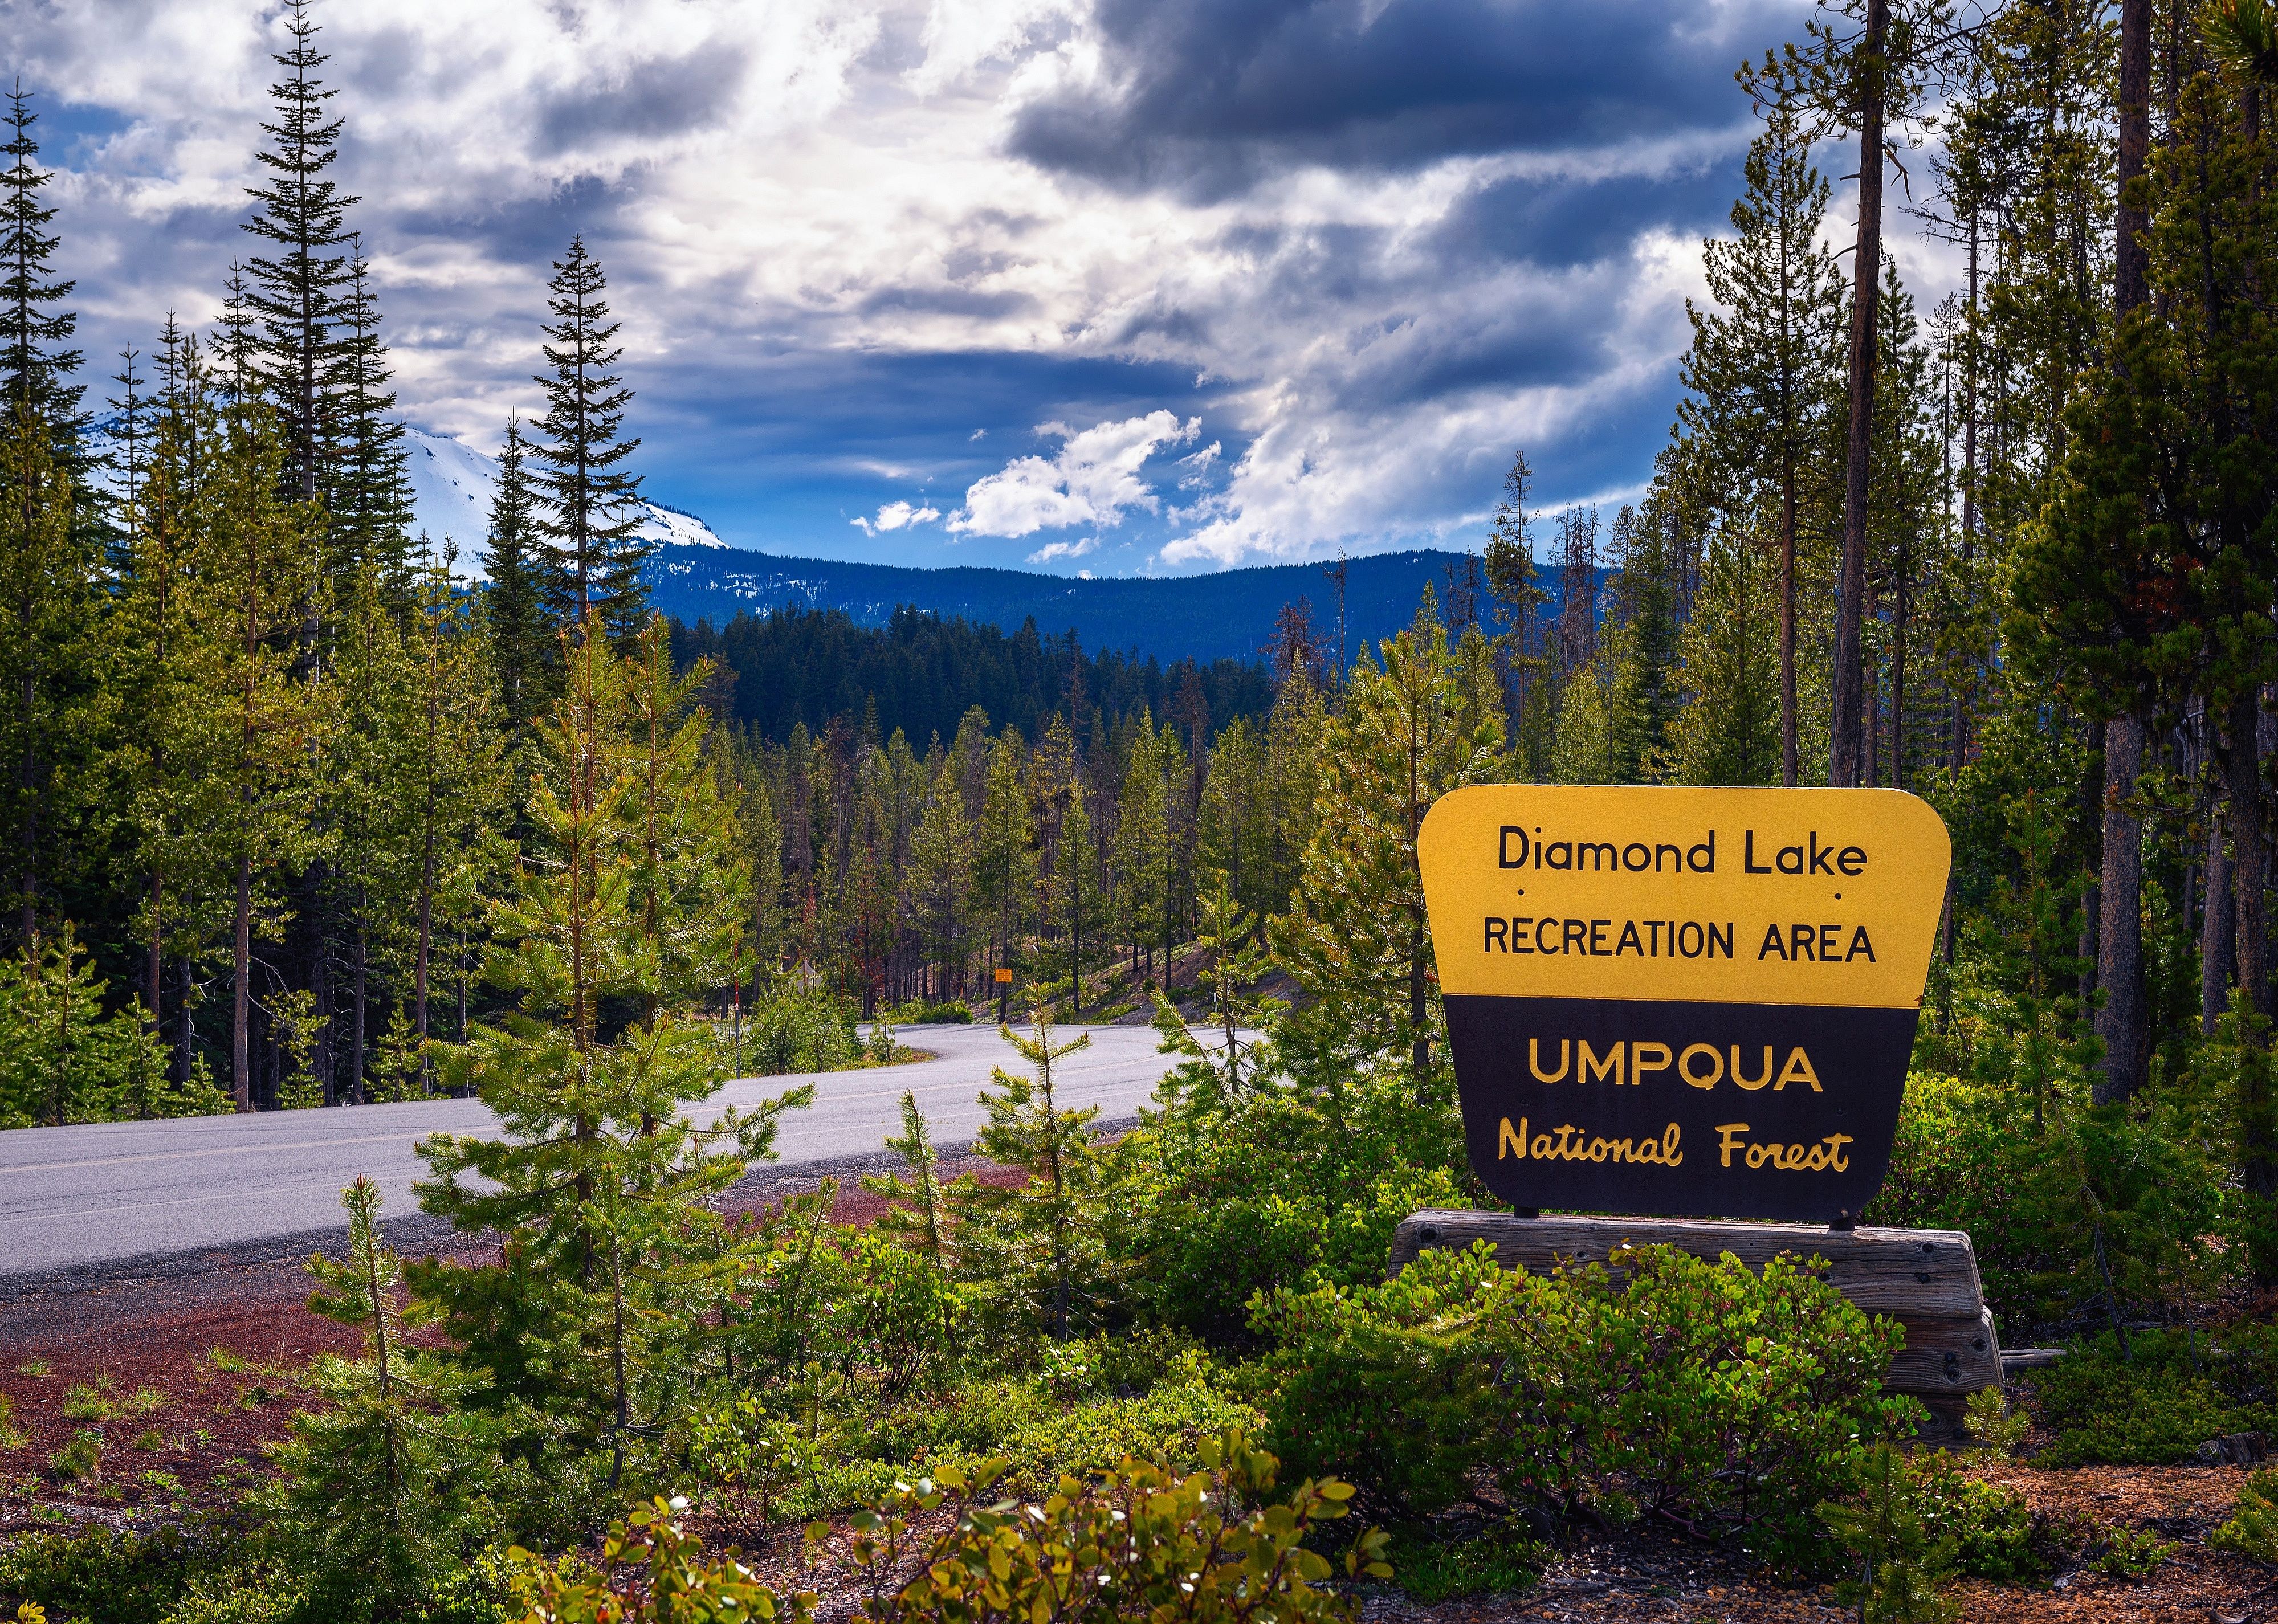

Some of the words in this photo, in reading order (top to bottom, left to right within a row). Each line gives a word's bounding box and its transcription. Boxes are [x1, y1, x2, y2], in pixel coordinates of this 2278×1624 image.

[1499, 826, 1714, 873] Diamond
[1745, 830, 1867, 876] Lake
[1485, 917, 1733, 958] RECREATION
[1758, 924, 1876, 962] AREA
[1530, 1039, 1823, 1091] UMPQUA
[1498, 1117, 1683, 1166] National
[1715, 1124, 1853, 1172] Forest
